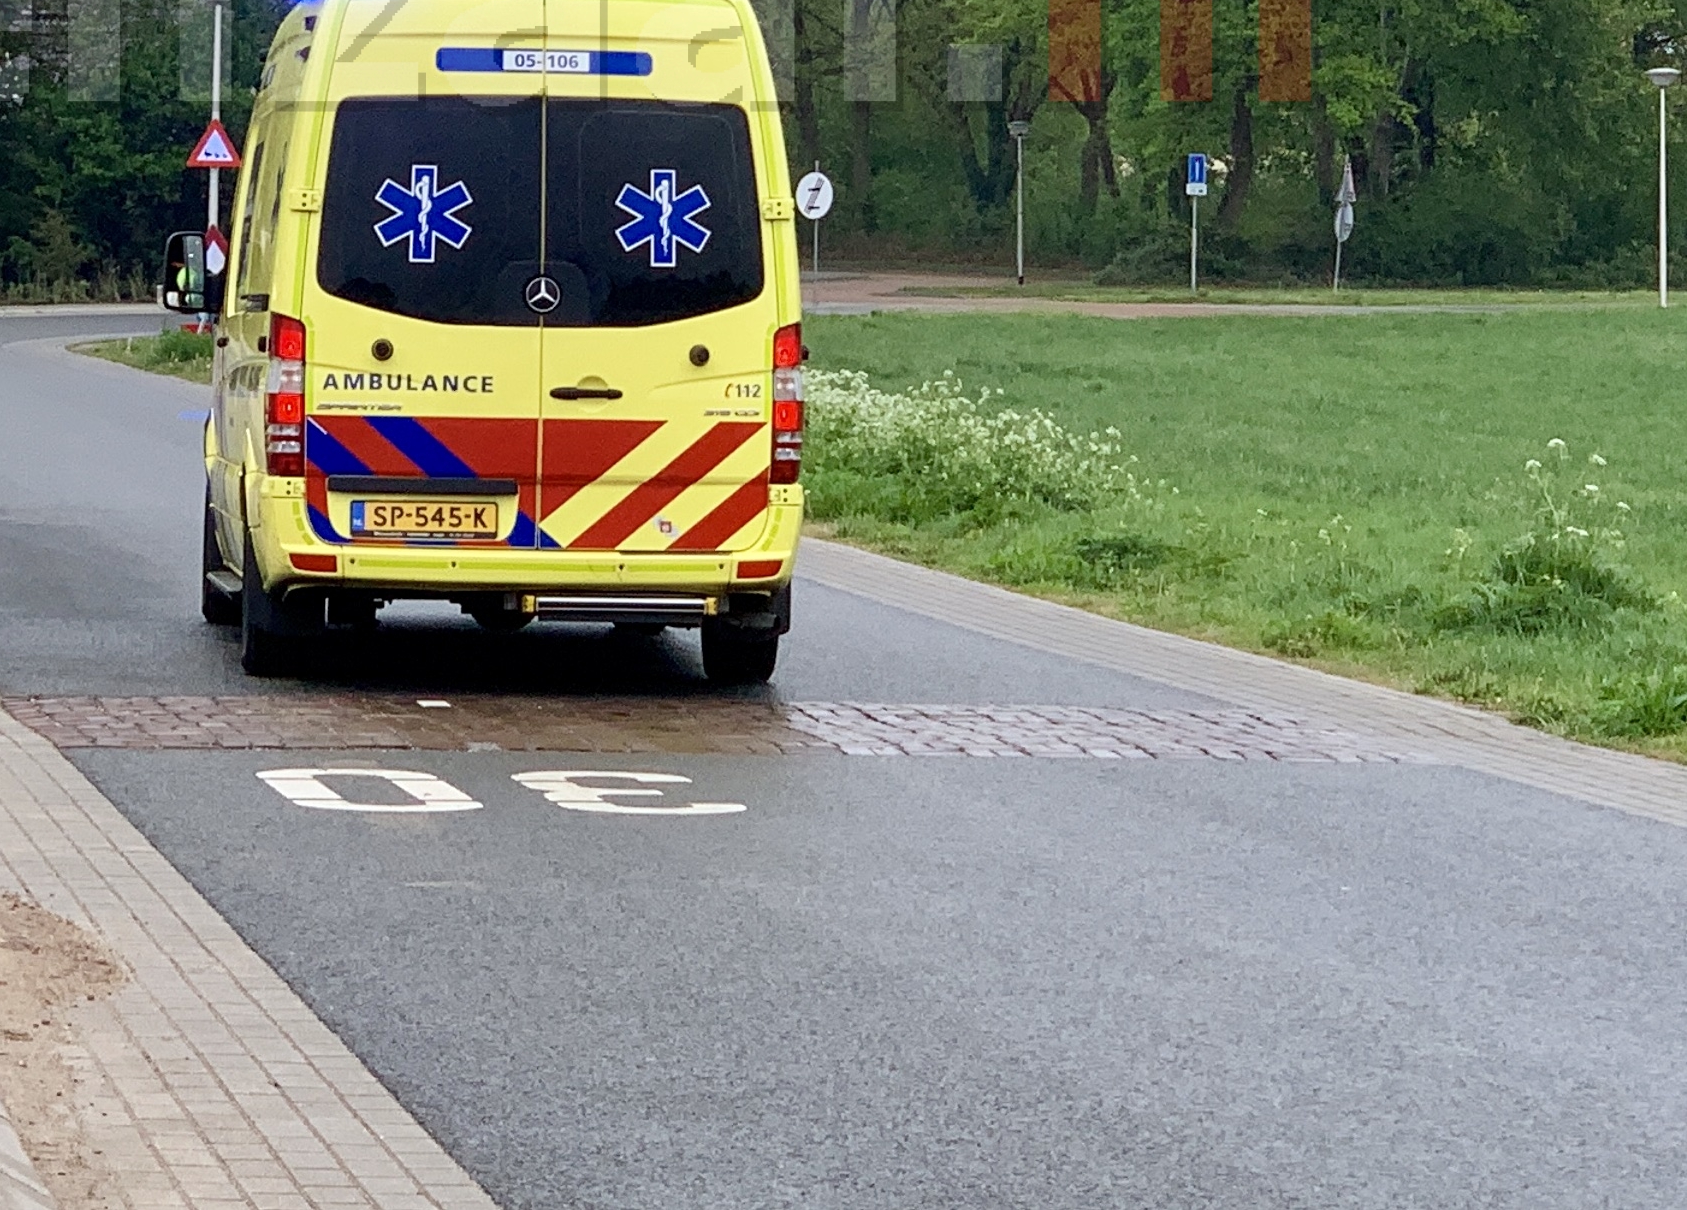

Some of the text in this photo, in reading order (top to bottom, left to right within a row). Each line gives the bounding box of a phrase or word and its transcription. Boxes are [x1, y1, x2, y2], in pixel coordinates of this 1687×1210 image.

[514, 53, 579, 69] 05-106
[322, 373, 494, 394] AMBULANCE
[735, 383, 761, 398] 112
[373, 506, 487, 529] SP-545-K
